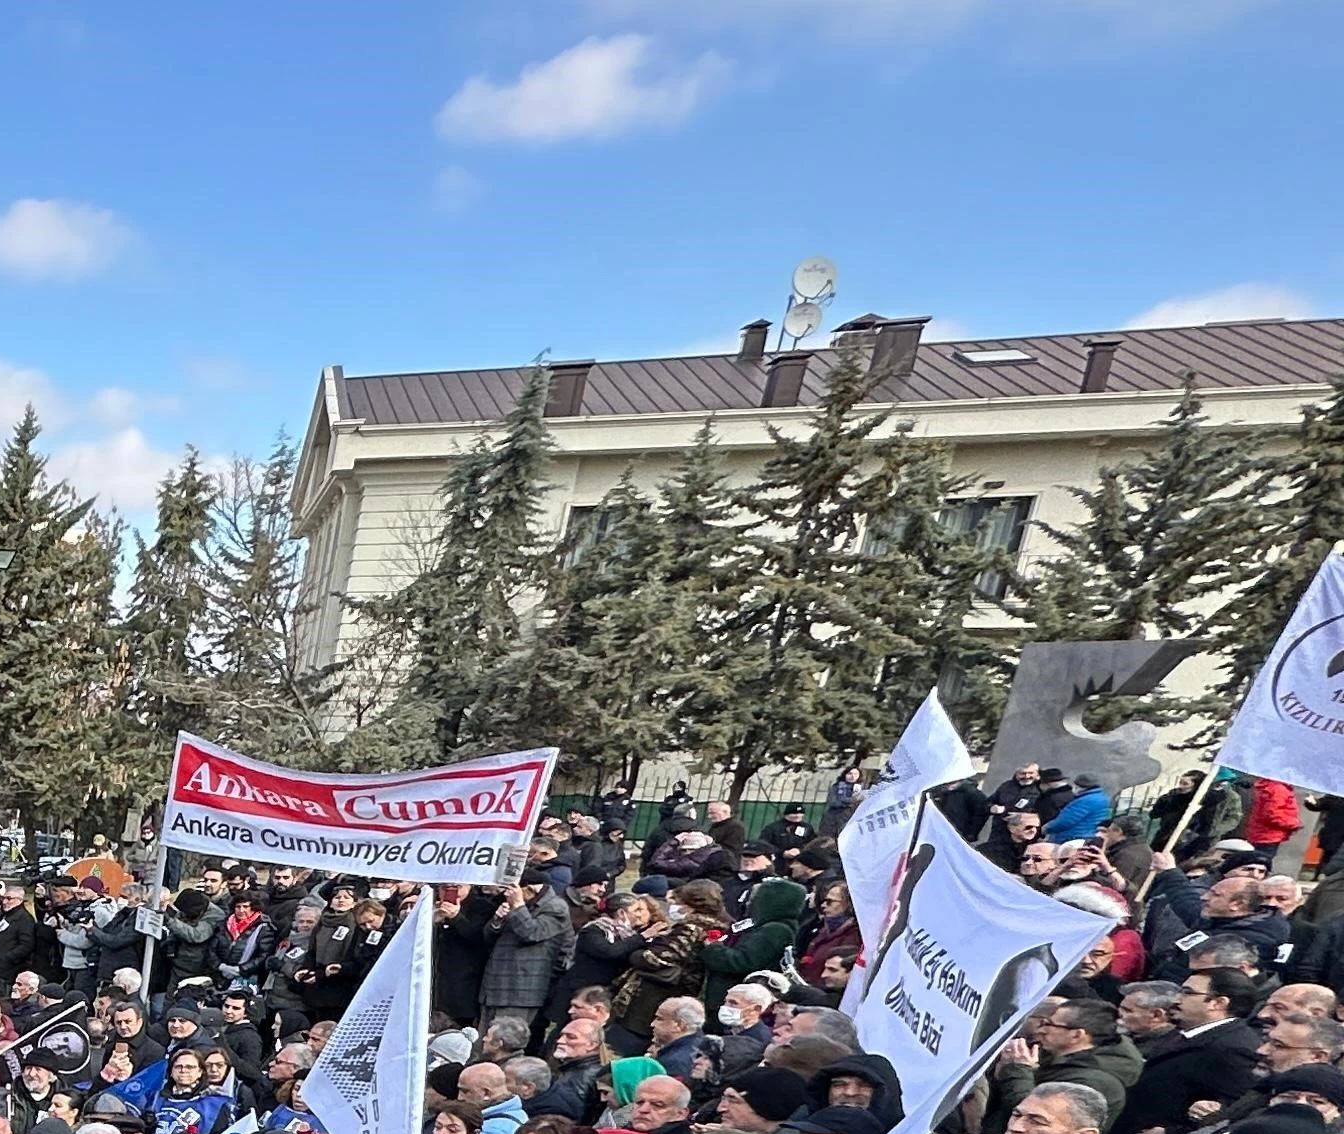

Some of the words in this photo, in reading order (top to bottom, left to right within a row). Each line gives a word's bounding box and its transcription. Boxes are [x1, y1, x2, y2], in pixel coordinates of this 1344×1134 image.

[181, 761, 330, 819] Ankara
[343, 779, 524, 822] Cumok
[171, 812, 254, 845] Ankara
[259, 829, 412, 866] Cumhuriyet
[918, 1011, 945, 1056] Bizi
